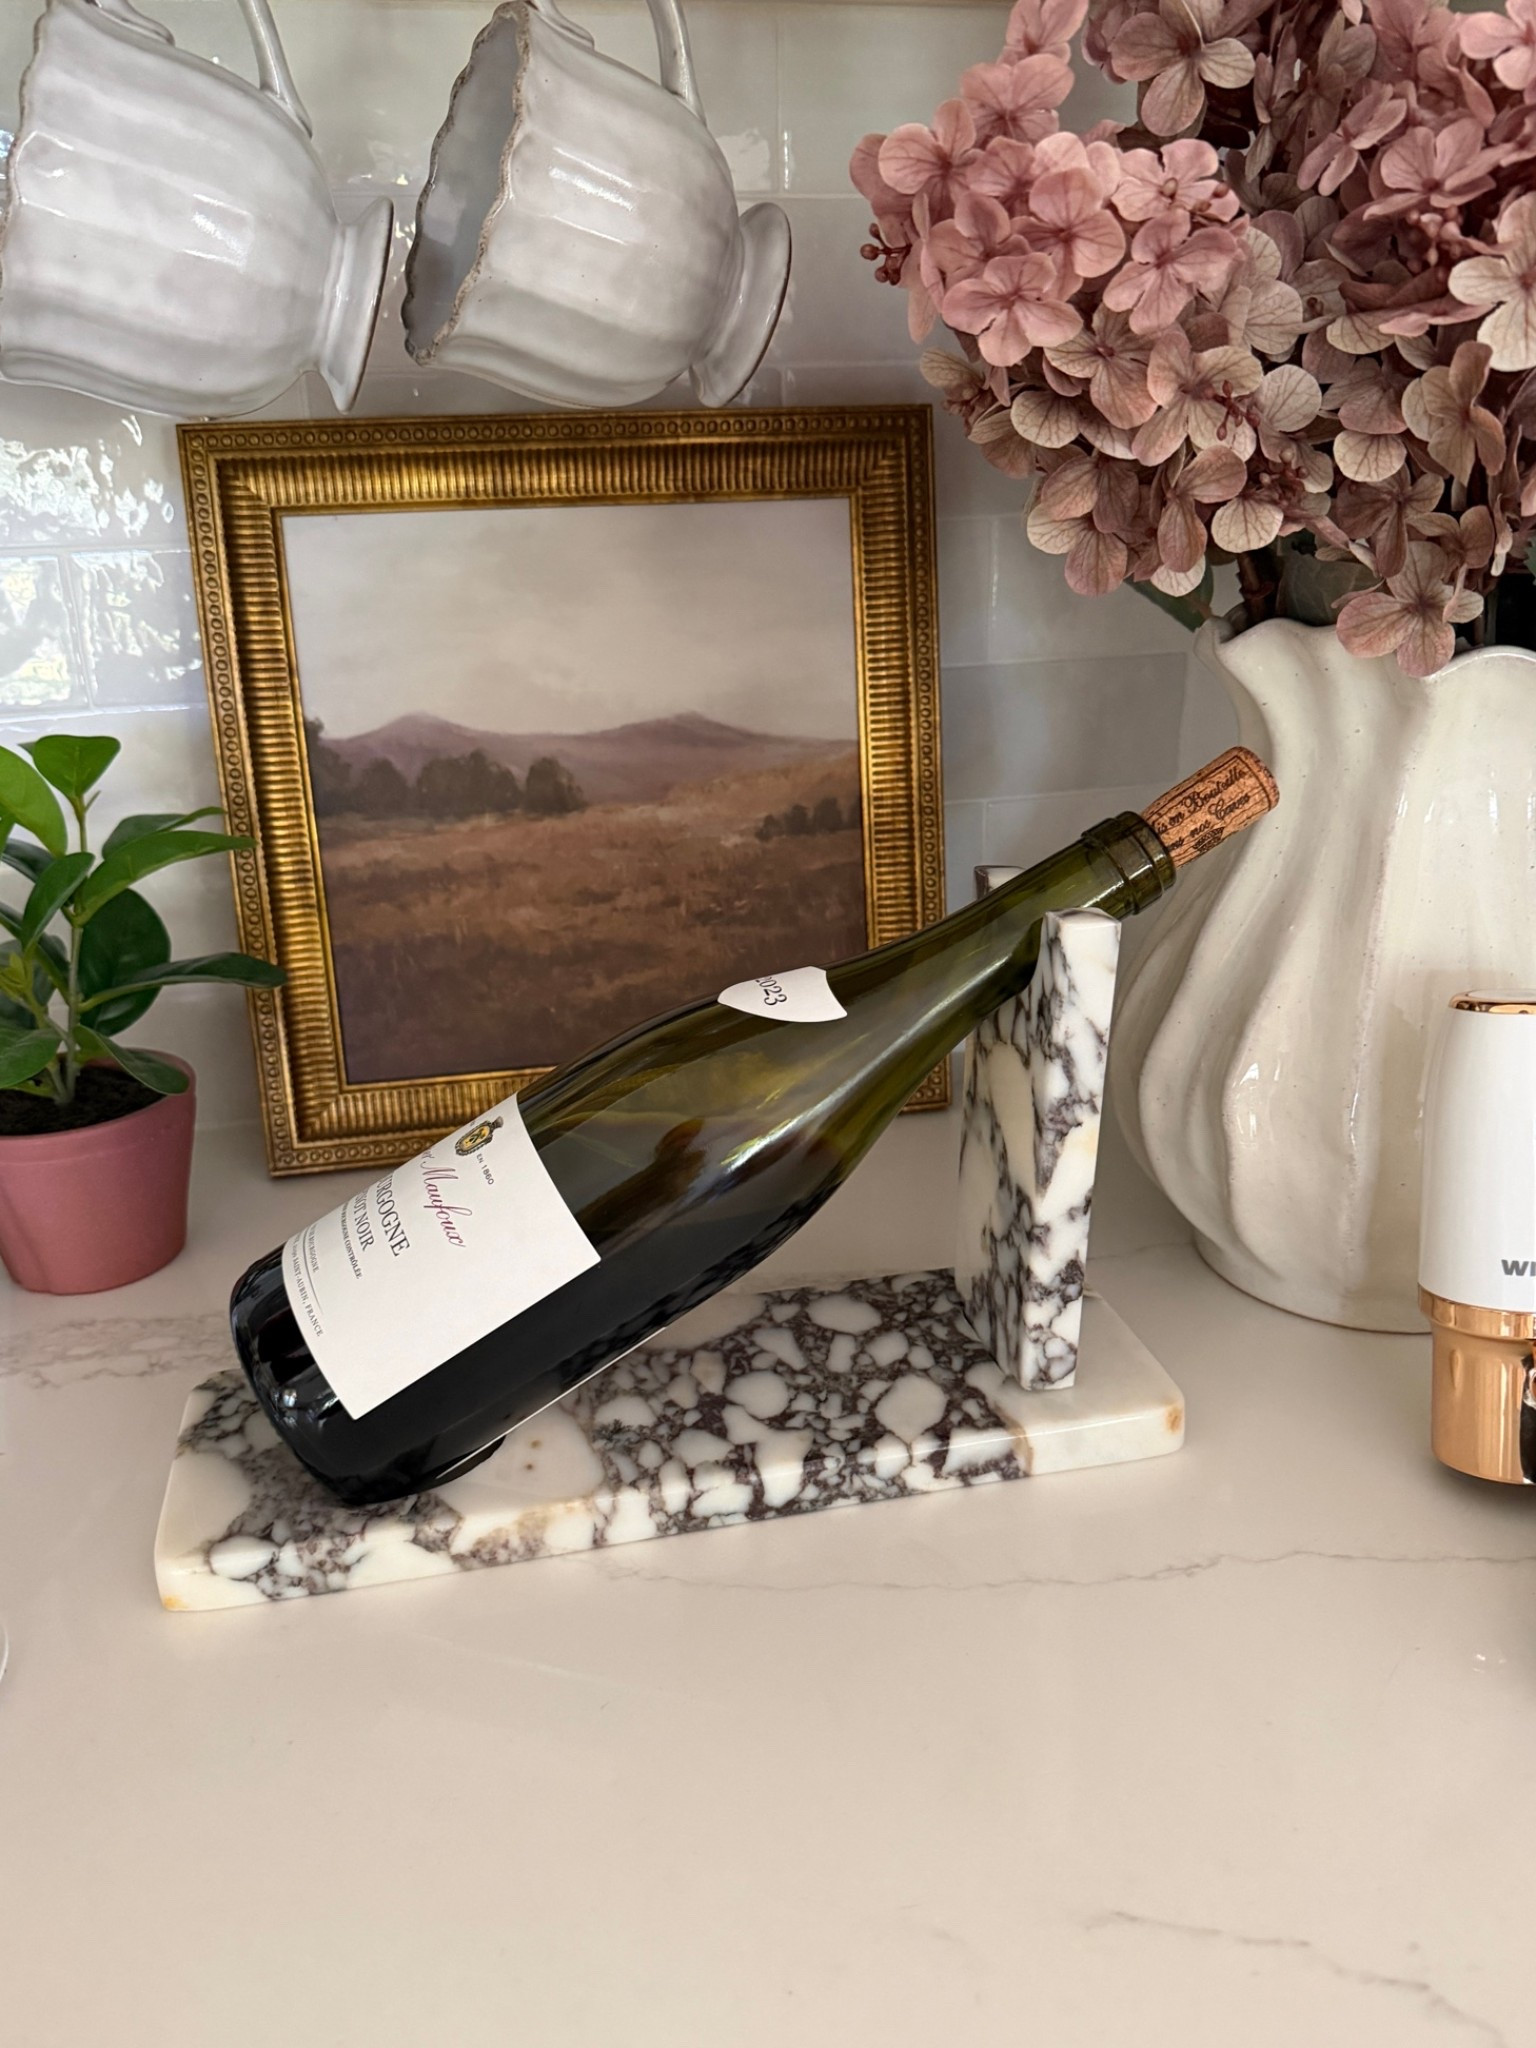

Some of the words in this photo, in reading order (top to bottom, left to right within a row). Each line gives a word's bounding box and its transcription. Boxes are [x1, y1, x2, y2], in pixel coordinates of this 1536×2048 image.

[354, 1213, 375, 1252] NOIR
[376, 1176, 410, 1257] URGOGNE
[420, 1160, 473, 1248] Maufoux
[304, 1303, 324, 1337] FRANCE
